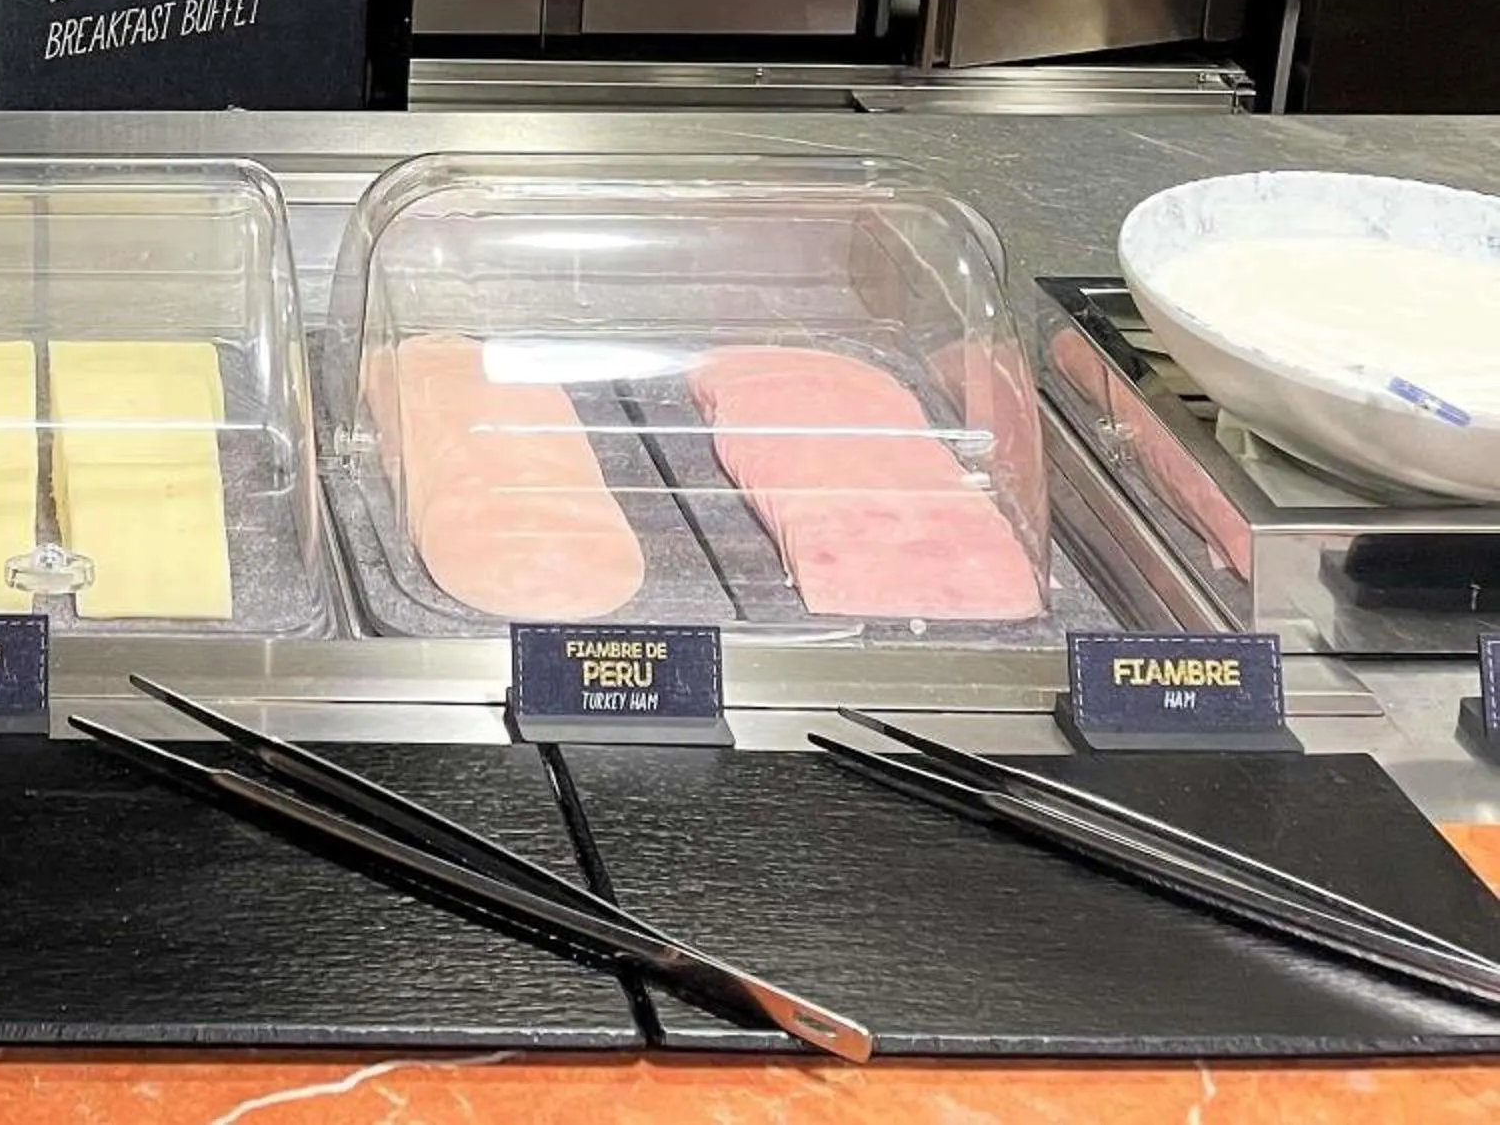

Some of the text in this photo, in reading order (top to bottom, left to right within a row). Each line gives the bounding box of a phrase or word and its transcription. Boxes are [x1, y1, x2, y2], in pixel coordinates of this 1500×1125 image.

[44, 1, 177, 60] BREAKFAST
[565, 640, 668, 660] FIAMBRE DE
[582, 661, 653, 688] PERU
[1113, 658, 1241, 687] FIAMBRE
[581, 691, 659, 711] TURKEY HAM
[1164, 690, 1196, 709] HAM
